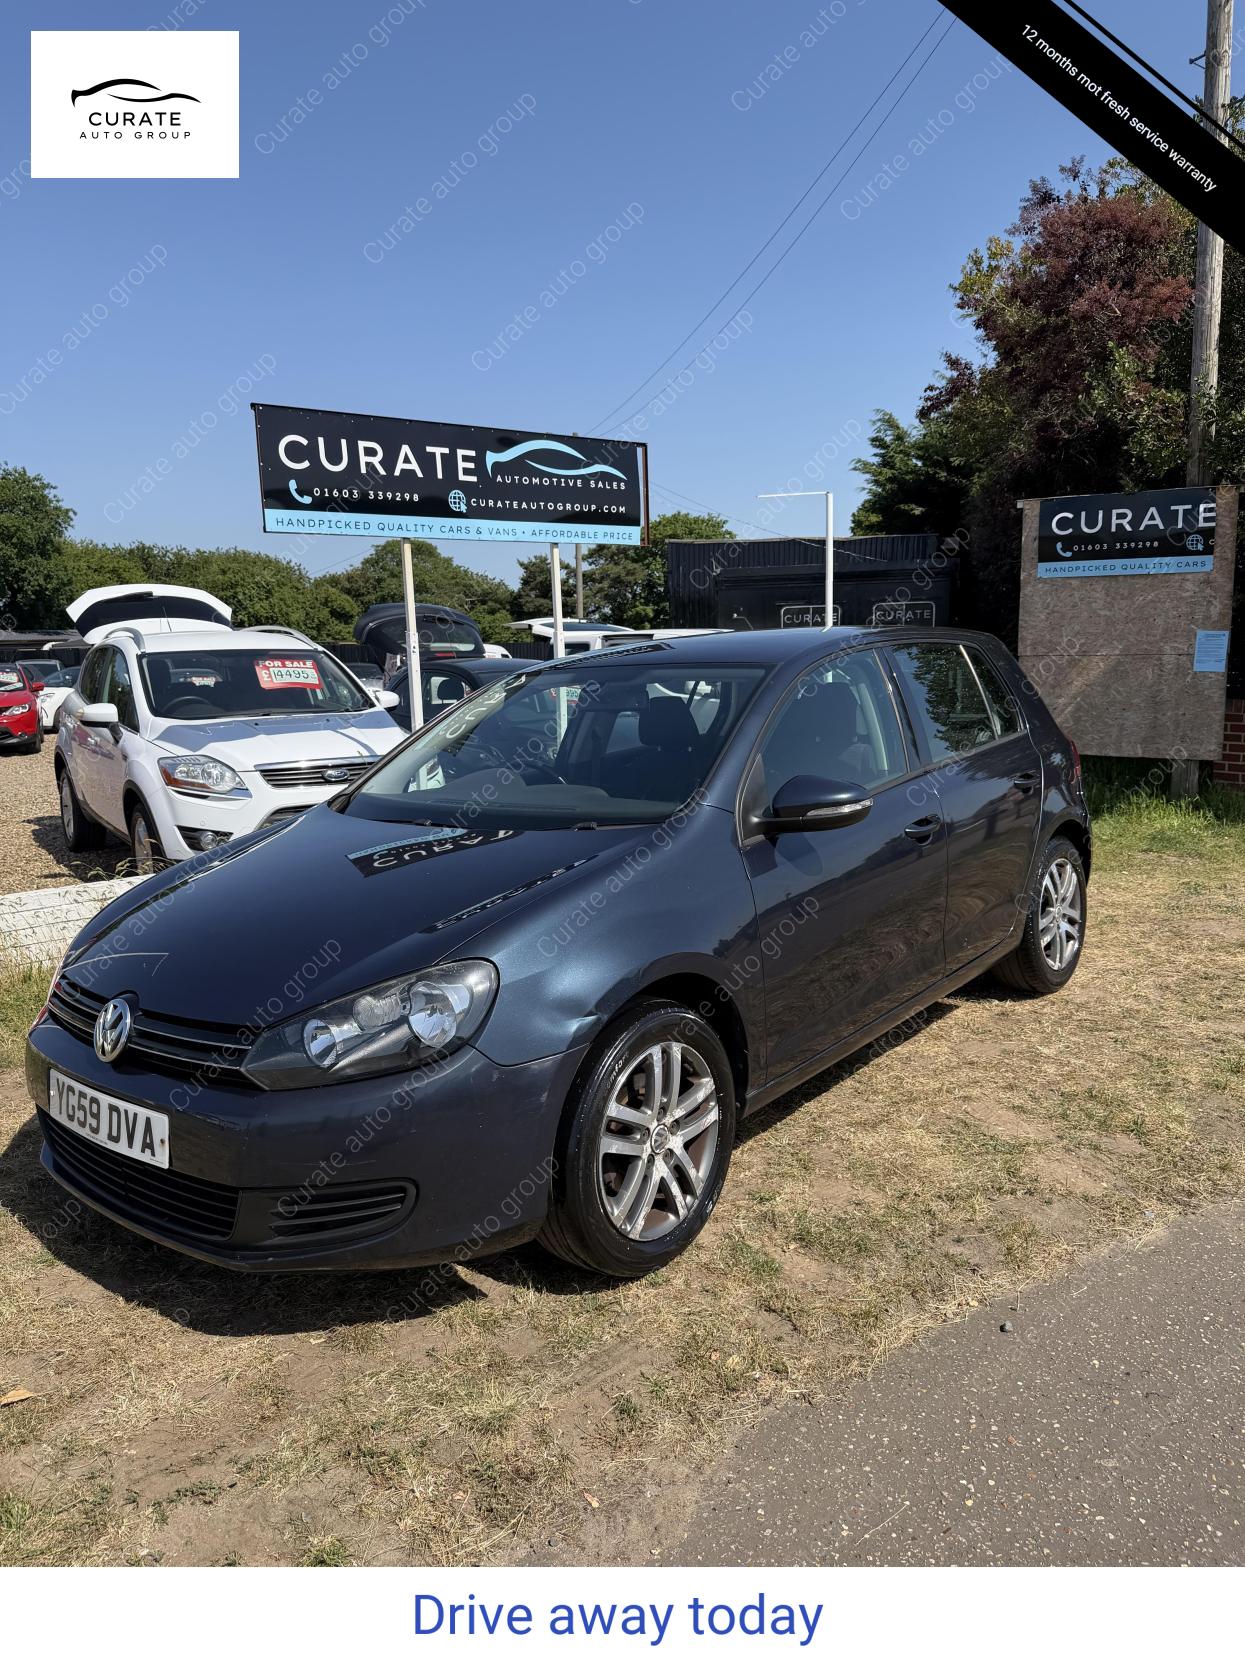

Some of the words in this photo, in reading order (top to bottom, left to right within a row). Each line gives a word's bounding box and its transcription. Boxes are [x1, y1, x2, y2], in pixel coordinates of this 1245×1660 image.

[278, 434, 478, 482] CURATE
[496, 474, 583, 487] AUTOMOTIVE
[590, 480, 626, 490] SALES
[313, 487, 359, 499] 01603
[368, 490, 419, 502] 339298
[470, 498, 626, 513] CURATEAUTOGROUP.COM
[1051, 502, 1216, 536] CURATE
[276, 517, 372, 531] HANDPICKED
[377, 521, 434, 533] QUALITY
[439, 525, 472, 535] CARS
[475, 526, 483, 535] &
[487, 527, 517, 536] VANS
[531, 529, 599, 539] AFFORDABLE
[603, 531, 633, 540] PRICE
[1073, 543, 1108, 552] 01603
[1115, 540, 1159, 550] 339298
[1045, 563, 1116, 574] HANDPICKED
[1120, 560, 1172, 571] QUALITY
[1176, 559, 1207, 569] CARS
[784, 612, 838, 624] CURAE
[258, 660, 282, 668] FOR
[284, 660, 314, 668] SALE
[56, 1078, 101, 1135] YG59
[107, 1102, 156, 1157] DVA
